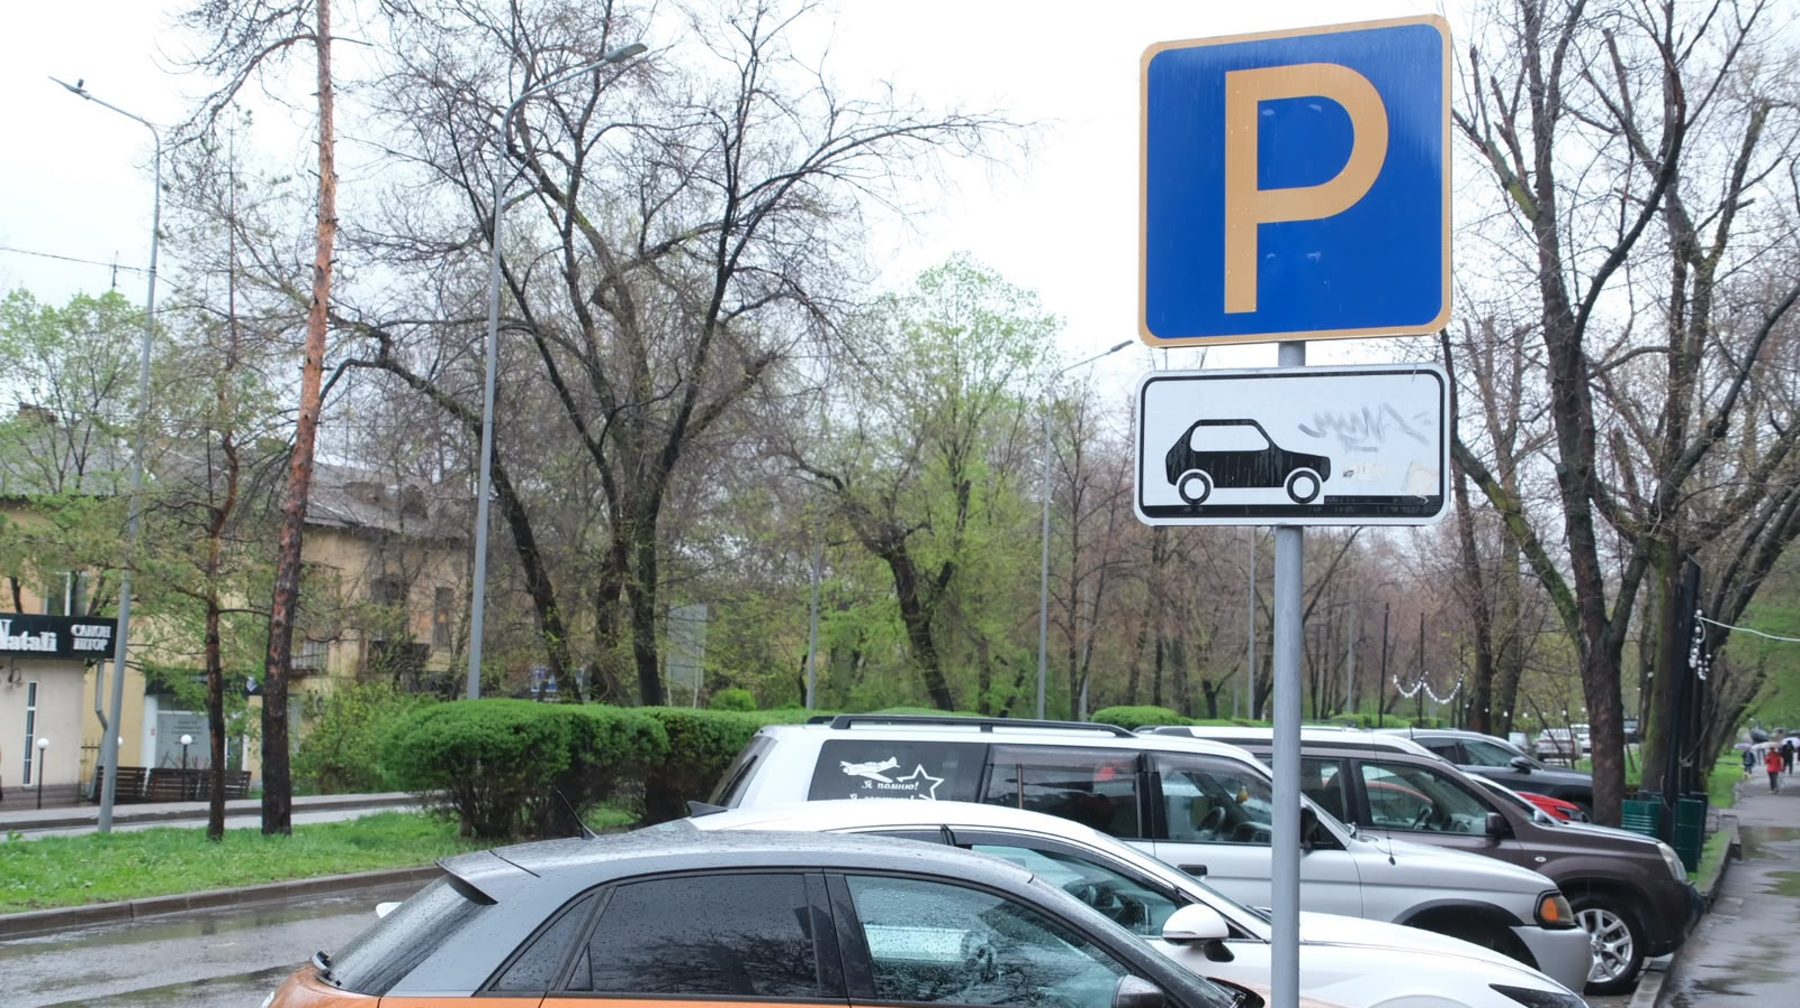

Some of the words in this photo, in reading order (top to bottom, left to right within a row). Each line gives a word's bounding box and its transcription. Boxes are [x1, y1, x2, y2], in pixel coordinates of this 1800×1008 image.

[1224, 62, 1389, 314] P
[70, 624, 111, 638] САЛОН
[73, 638, 108, 651] ШТОР
[861, 780, 873, 789] Я
[877, 781, 919, 790] помню!
